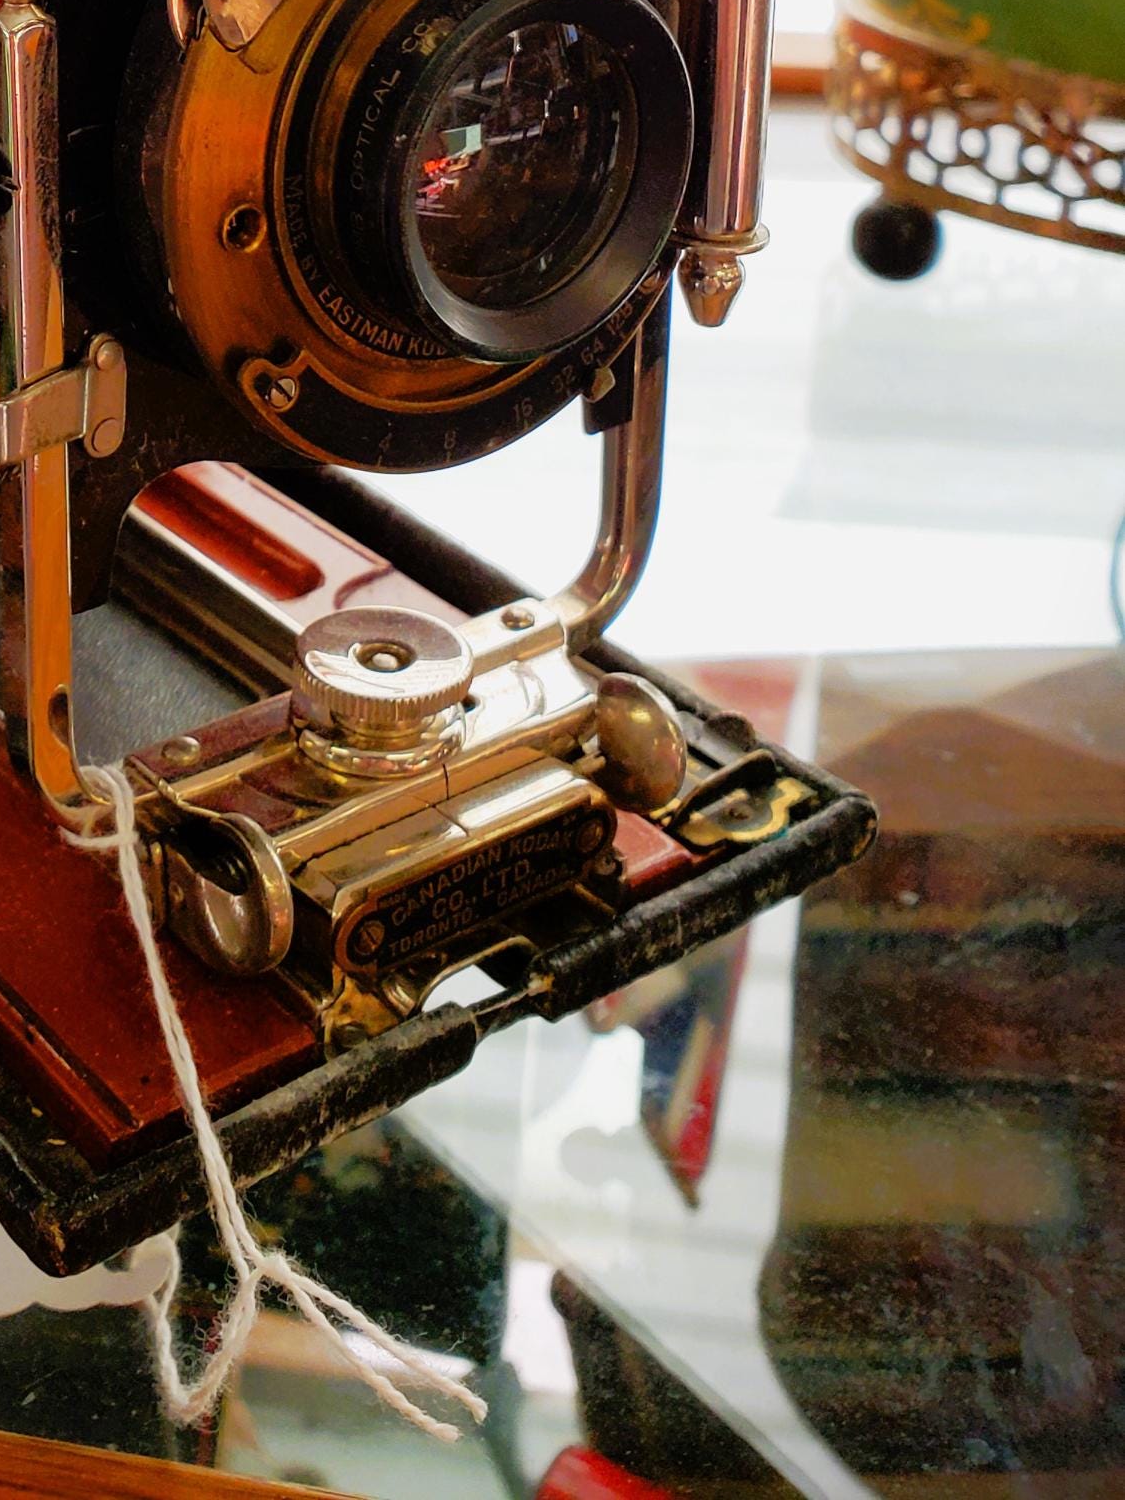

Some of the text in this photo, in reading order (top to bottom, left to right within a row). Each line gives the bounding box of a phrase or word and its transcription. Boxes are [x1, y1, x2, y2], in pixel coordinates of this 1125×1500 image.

[349, 68, 402, 191] OPTICAL
[284, 173, 308, 250] MADE
[299, 253, 324, 282] BY
[317, 283, 405, 353] EASTMAN
[442, 428, 458, 451] 8
[513, 396, 535, 422] 16
[579, 335, 606, 366] 64
[606, 301, 634, 336] 128
[391, 830, 573, 927] CANADIAN KODAK
